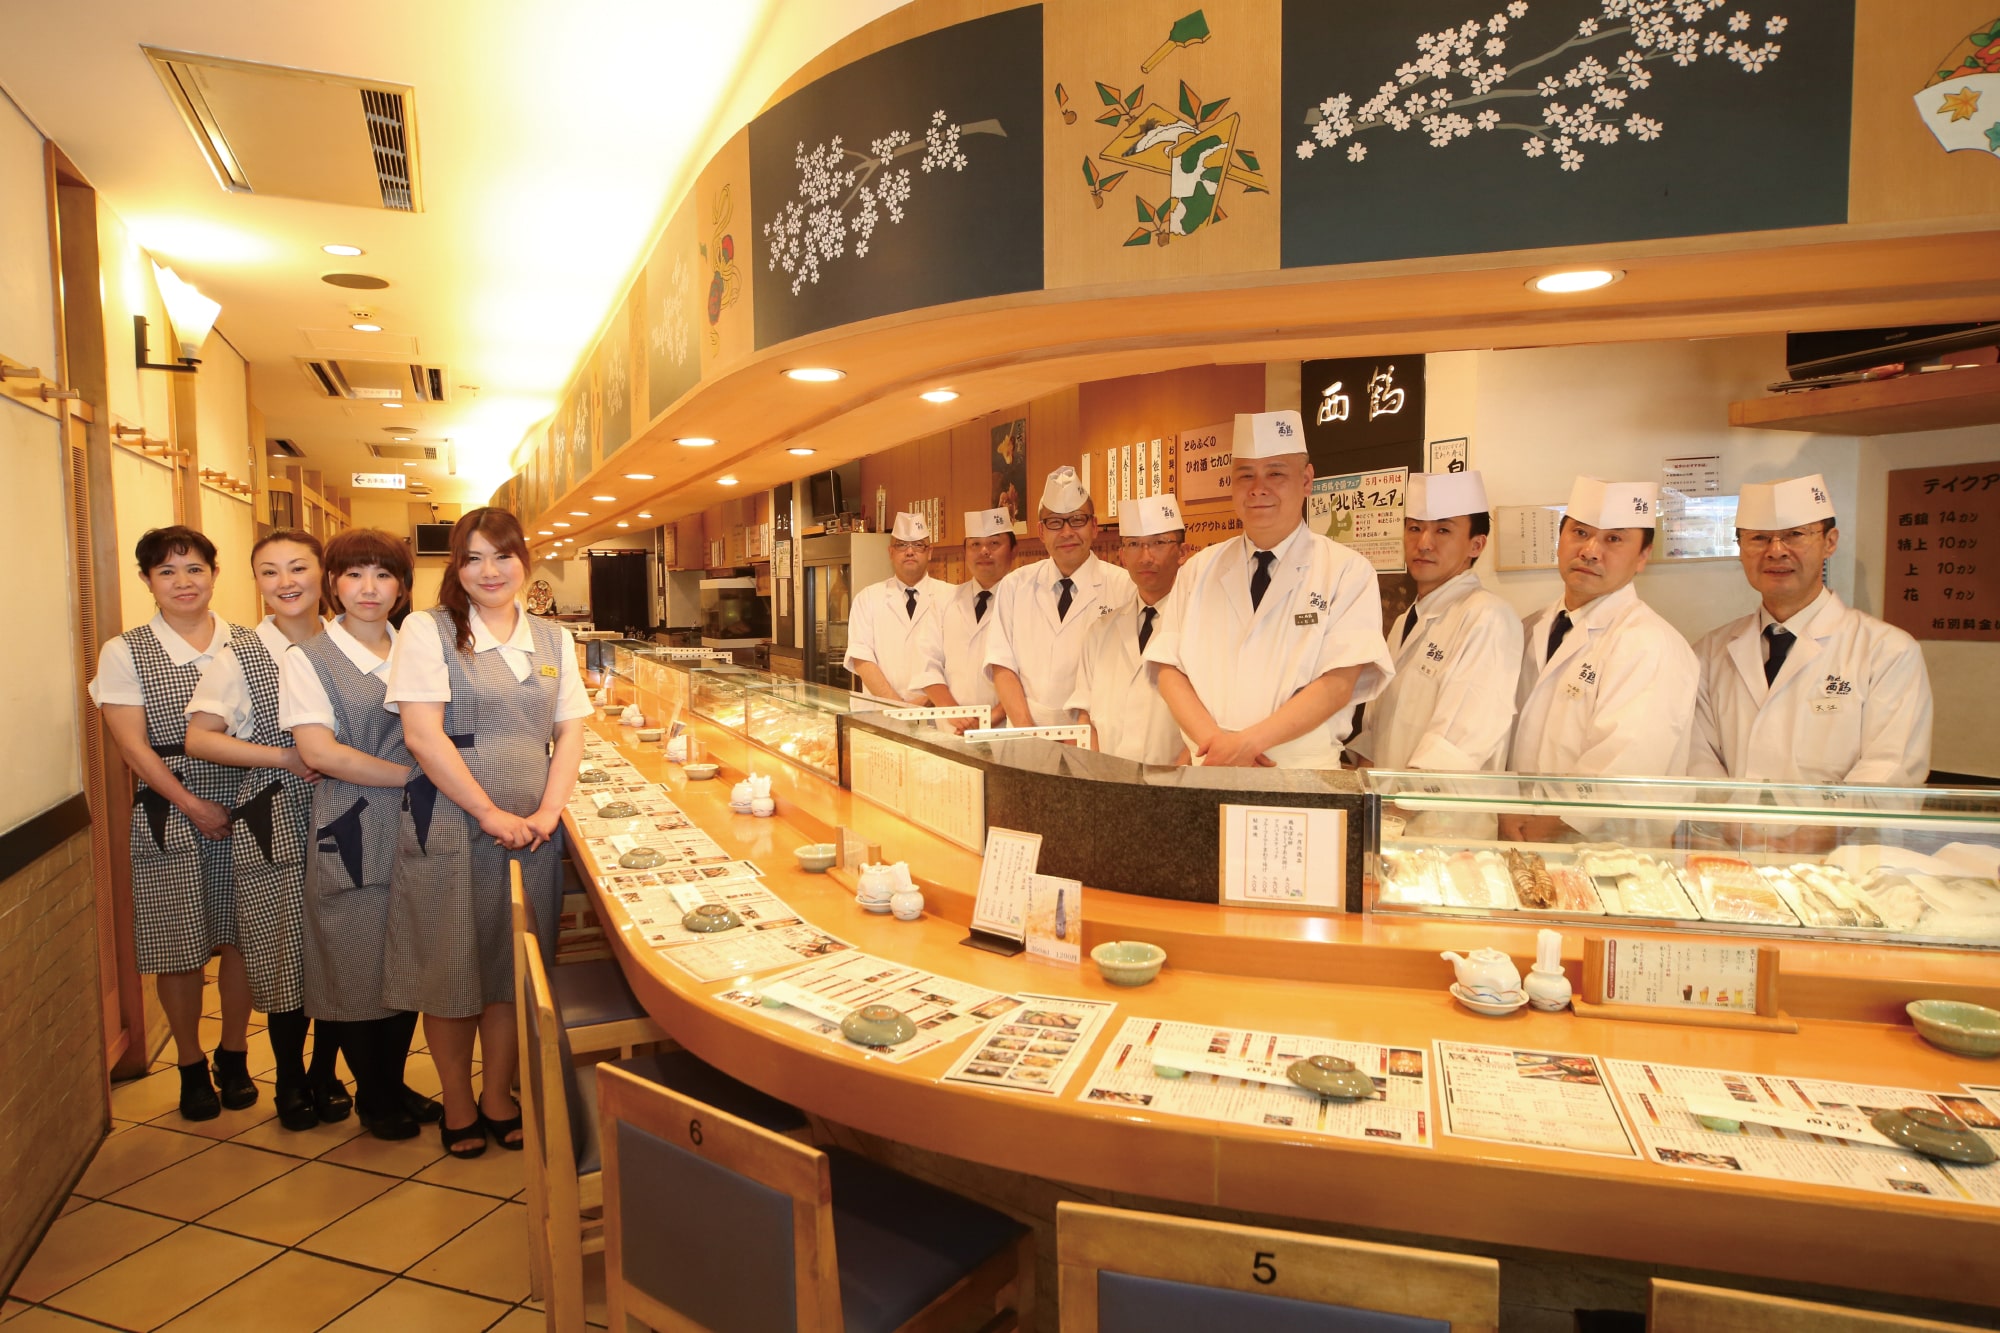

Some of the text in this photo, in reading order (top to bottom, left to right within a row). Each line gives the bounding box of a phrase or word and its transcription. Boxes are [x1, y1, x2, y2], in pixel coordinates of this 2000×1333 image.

[1316, 365, 1405, 426] 西鶴
[1184, 436, 1217, 451] とらふぐの
[1186, 458, 1208, 473] ひれ酒
[1365, 474, 1402, 486] 5月・6月は
[1898, 512, 1929, 527] 西鶴
[1897, 537, 1928, 551] 特上
[1905, 563, 1919, 576] 上
[1904, 587, 1919, 602] 花
[690, 1119, 703, 1145] 6
[1252, 1252, 1277, 1284] 5
